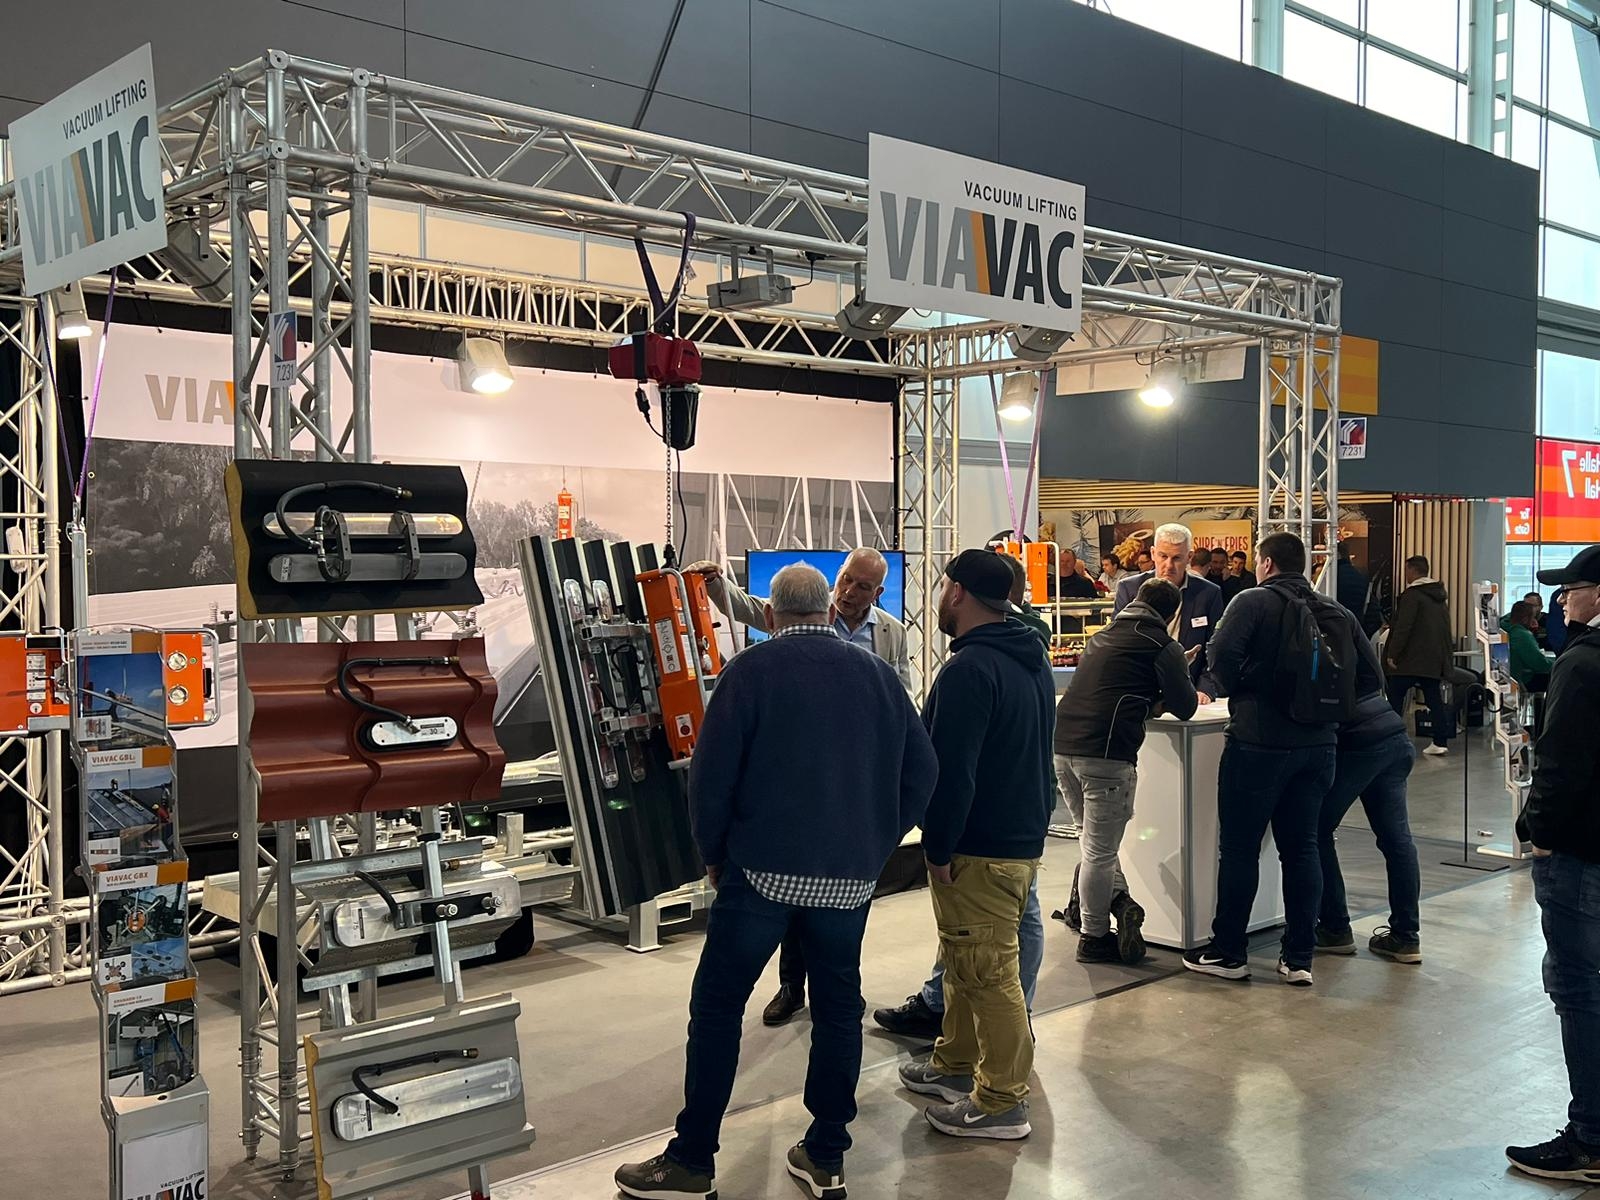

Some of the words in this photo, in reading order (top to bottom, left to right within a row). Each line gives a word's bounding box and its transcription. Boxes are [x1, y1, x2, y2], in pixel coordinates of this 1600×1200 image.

[63, 113, 102, 140] VACUUM
[105, 79, 147, 119] LIFTING
[20, 115, 157, 266] VIAVAC
[964, 180, 1022, 209] VACUUM
[1027, 197, 1077, 221] LIFTING
[880, 191, 1076, 309] VIAVAC
[276, 363, 294, 381] 7.231
[1342, 446, 1362, 457] 7.231
[91, 754, 118, 764] VIAVAC
[105, 873, 133, 883] VIAVAC
